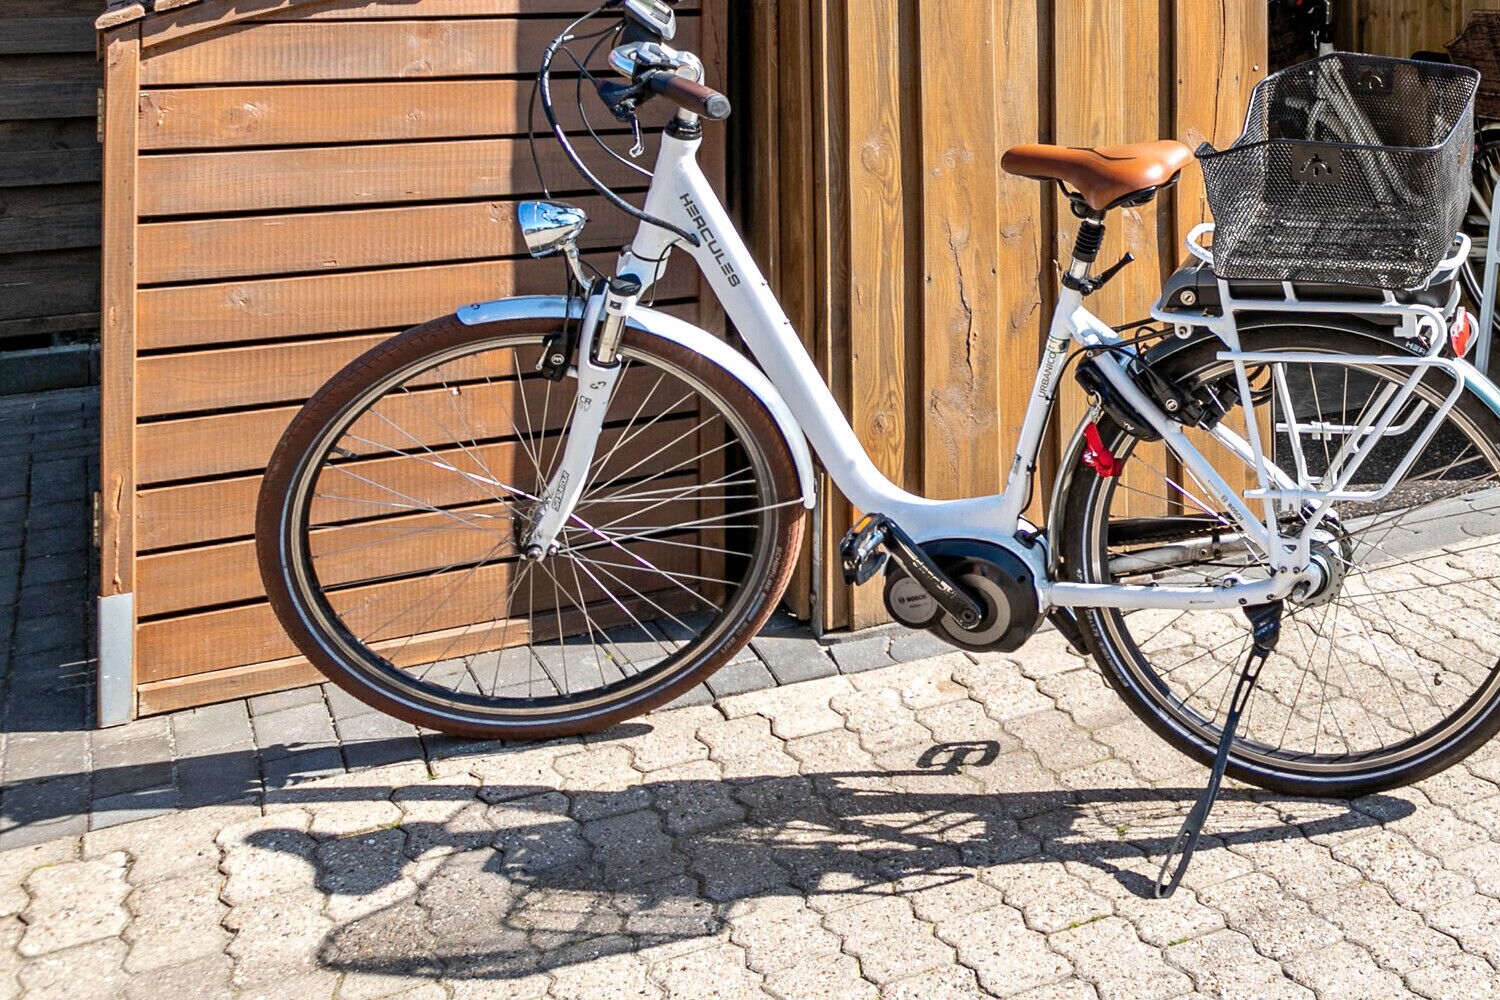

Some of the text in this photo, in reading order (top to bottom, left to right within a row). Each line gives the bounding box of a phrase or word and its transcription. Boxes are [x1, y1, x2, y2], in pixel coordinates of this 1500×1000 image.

[680, 193, 740, 288] HERCULES
[1038, 350, 1057, 398] URBANICO
[1228, 502, 1244, 521] BOSCH
